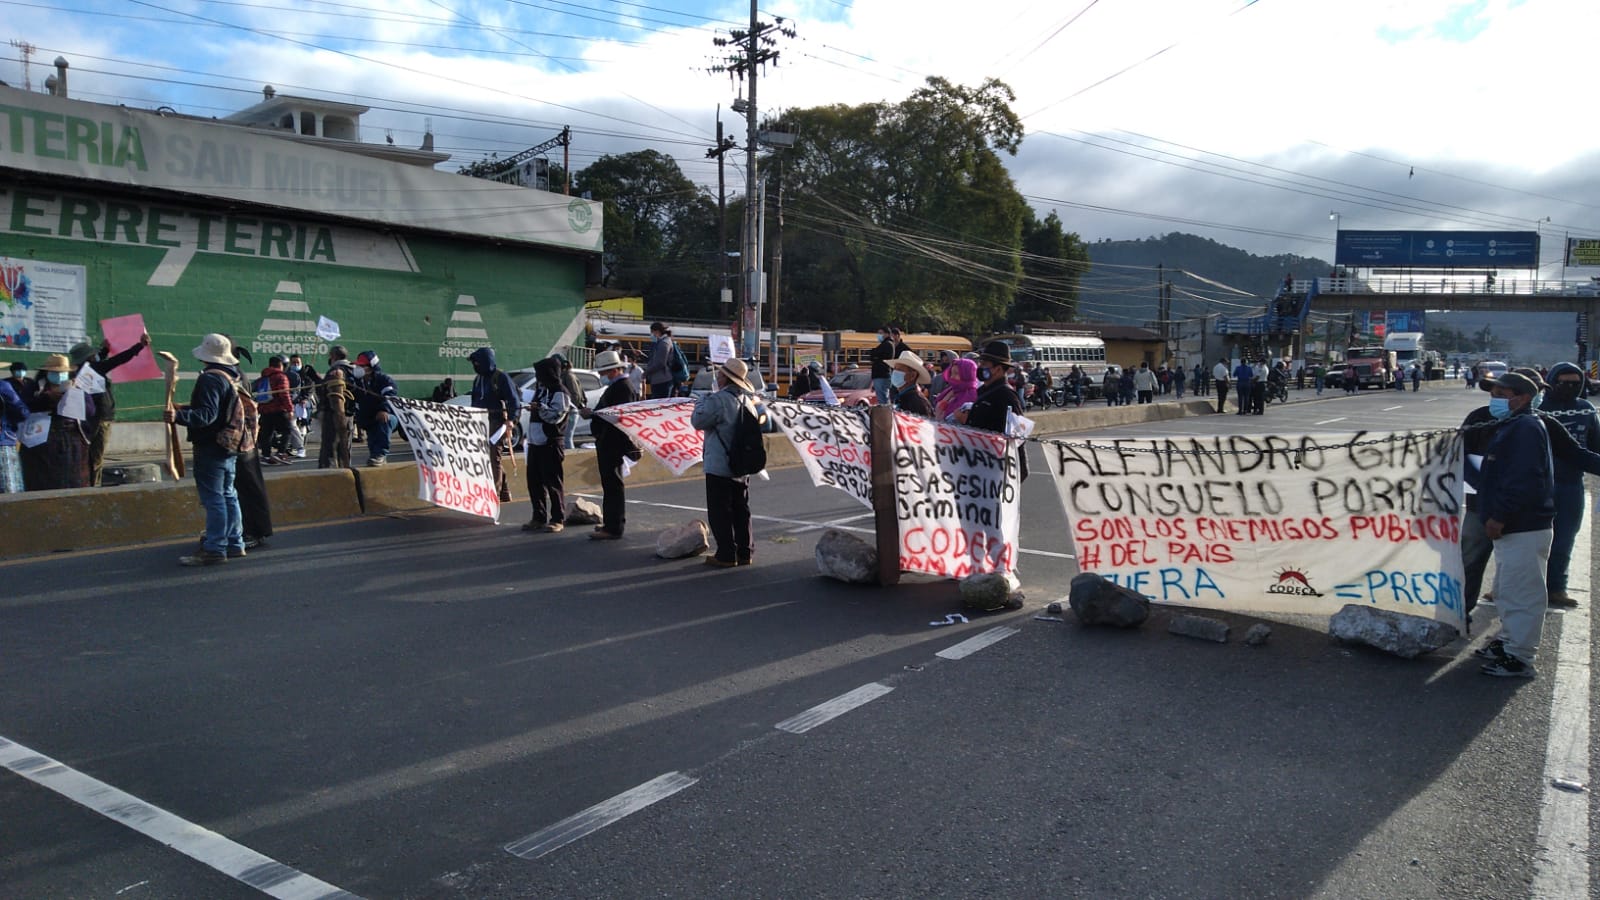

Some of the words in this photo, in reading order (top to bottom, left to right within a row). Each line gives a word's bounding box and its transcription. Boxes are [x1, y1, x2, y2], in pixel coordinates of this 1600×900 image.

[0, 104, 148, 171] TERIA
[166, 133, 253, 187] SAN
[0, 189, 337, 262] ERRETERIA
[1579, 239, 1600, 249] HOT
[252, 341, 329, 355] PROGRESO
[1056, 435, 1325, 478] ALEJANDRO
[1070, 480, 1284, 517] CONSUELO
[1311, 472, 1460, 516] PORRAS
[1076, 516, 1134, 541] SON
[1140, 517, 1187, 540] LOS
[1196, 517, 1339, 543] ENEMIGOS
[1351, 514, 1459, 544] PUBLICOS
[904, 527, 1012, 573] CODECA
[1112, 540, 1158, 567] DEL
[1168, 542, 1235, 565] PAIS
[1269, 584, 1318, 596] CODECA
